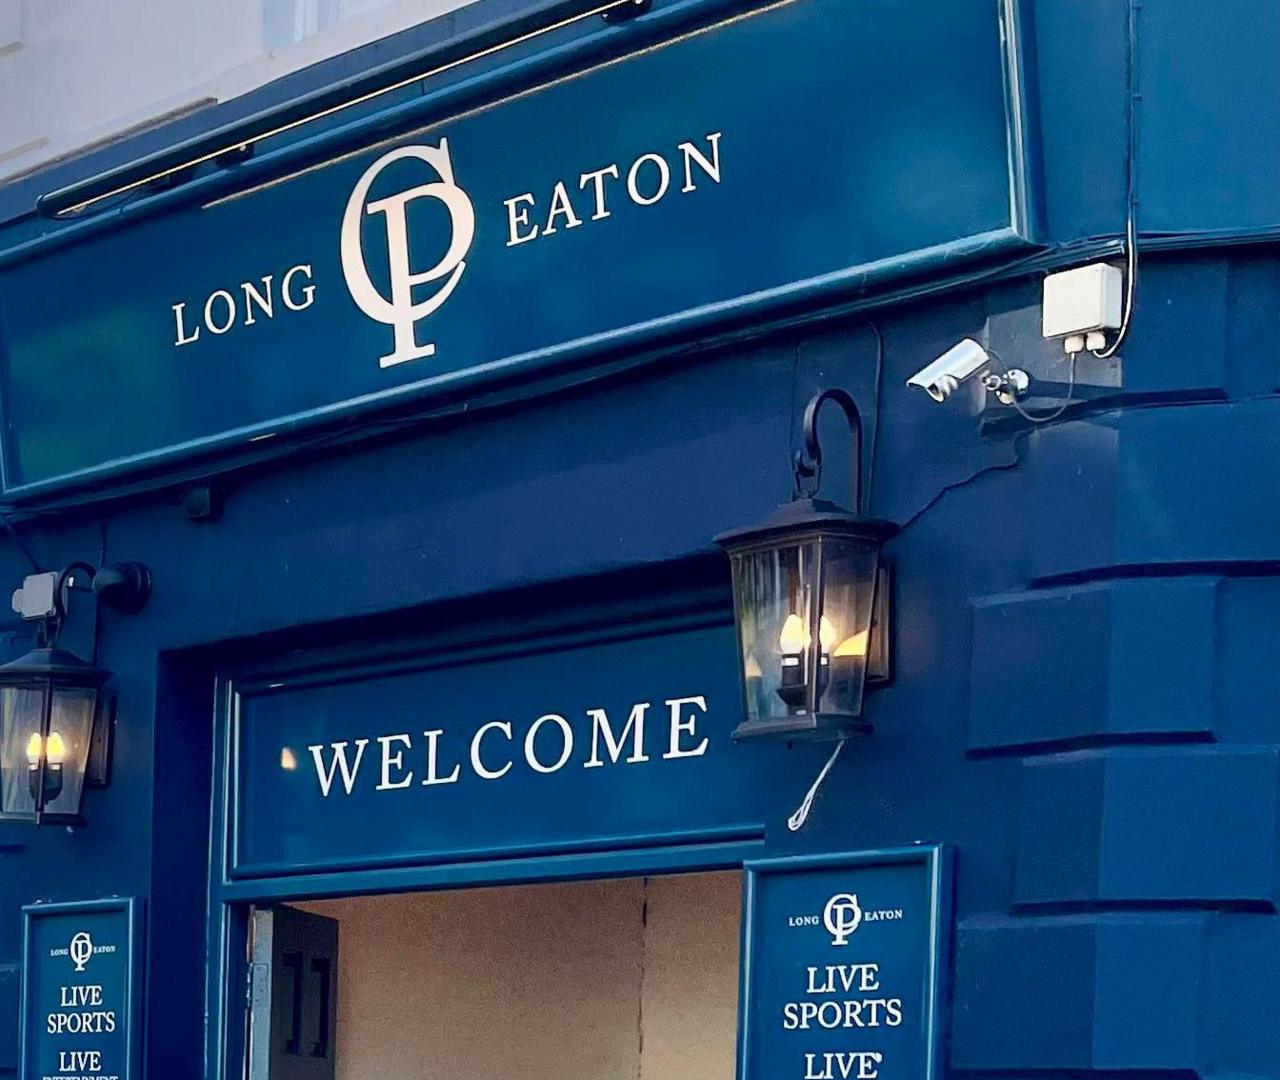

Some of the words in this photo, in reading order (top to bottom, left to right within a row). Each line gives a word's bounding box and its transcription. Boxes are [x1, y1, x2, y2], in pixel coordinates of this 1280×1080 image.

[171, 264, 316, 346] LONG
[502, 131, 723, 247] EATON
[307, 695, 710, 797] WELCOME
[788, 914, 820, 927] LONG
[864, 908, 903, 922] EATON
[49, 947, 69, 957] LONG
[93, 944, 117, 955] EATON
[805, 963, 880, 994] LIVE
[60, 985, 103, 1007] LIVE
[47, 1011, 116, 1034] SPORTS
[783, 998, 903, 1030] SPORTS
[58, 1051, 102, 1072] LIVE
[804, 1051, 879, 1080] LIVE
